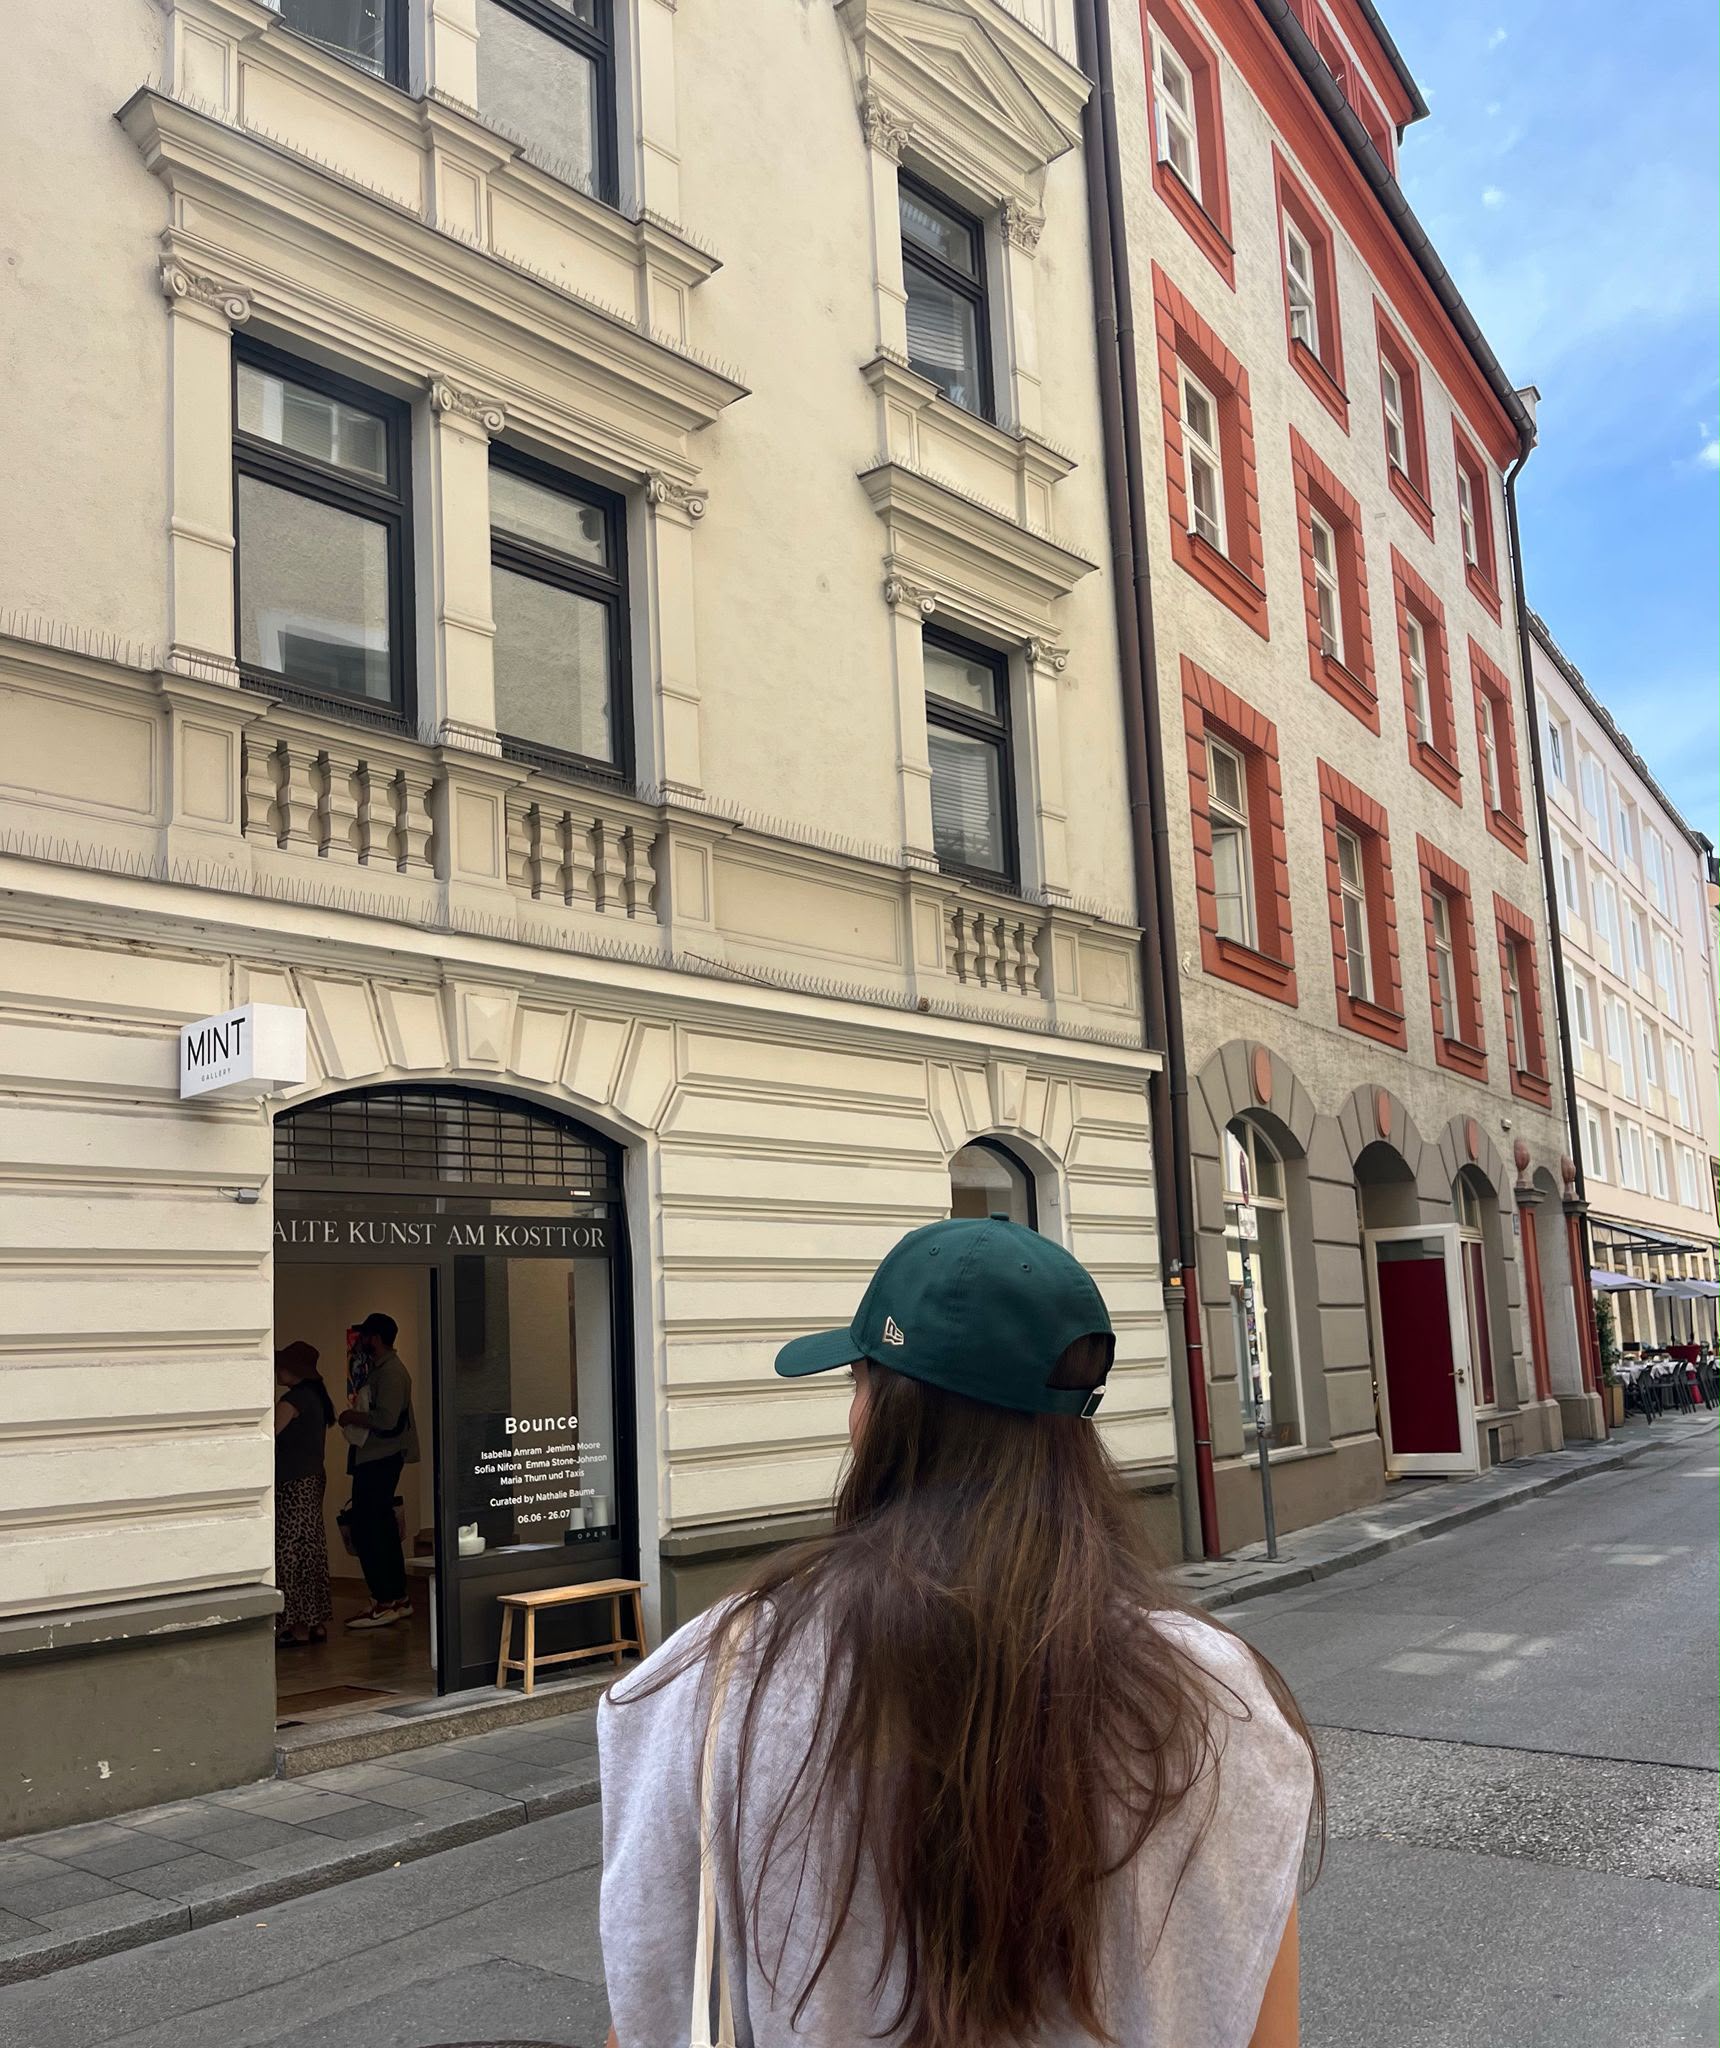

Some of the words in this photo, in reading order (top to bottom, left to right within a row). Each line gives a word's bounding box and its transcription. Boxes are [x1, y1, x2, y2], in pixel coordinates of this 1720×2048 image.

[187, 1017, 245, 1071] MINT
[201, 1067, 231, 1082] GALLERY
[274, 1220, 339, 1243] ALTE
[348, 1221, 437, 1245] KUNST
[447, 1224, 485, 1246] AM
[495, 1224, 606, 1248] KOSTTOR
[505, 1415, 579, 1435] Bounce
[481, 1450, 512, 1460] Isabella
[513, 1448, 542, 1457] Amram
[546, 1443, 576, 1454] Jemima
[576, 1441, 601, 1450] Moore
[474, 1464, 496, 1475] Sofia
[497, 1462, 522, 1472] Nifora
[525, 1459, 550, 1469] Emma
[551, 1454, 607, 1466] Stone-Johnson
[500, 1475, 523, 1486] Maria
[524, 1473, 547, 1482] Thurn
[548, 1471, 564, 1480] und
[565, 1468, 585, 1478] Taxis
[490, 1496, 522, 1507] Curated
[523, 1494, 535, 1504] by
[535, 1490, 568, 1501] Nathalie
[569, 1487, 595, 1497] Baume
[517, 1513, 542, 1524] 06.06
[548, 1509, 571, 1520] 26.07
[577, 1530, 607, 1539] OPEN
